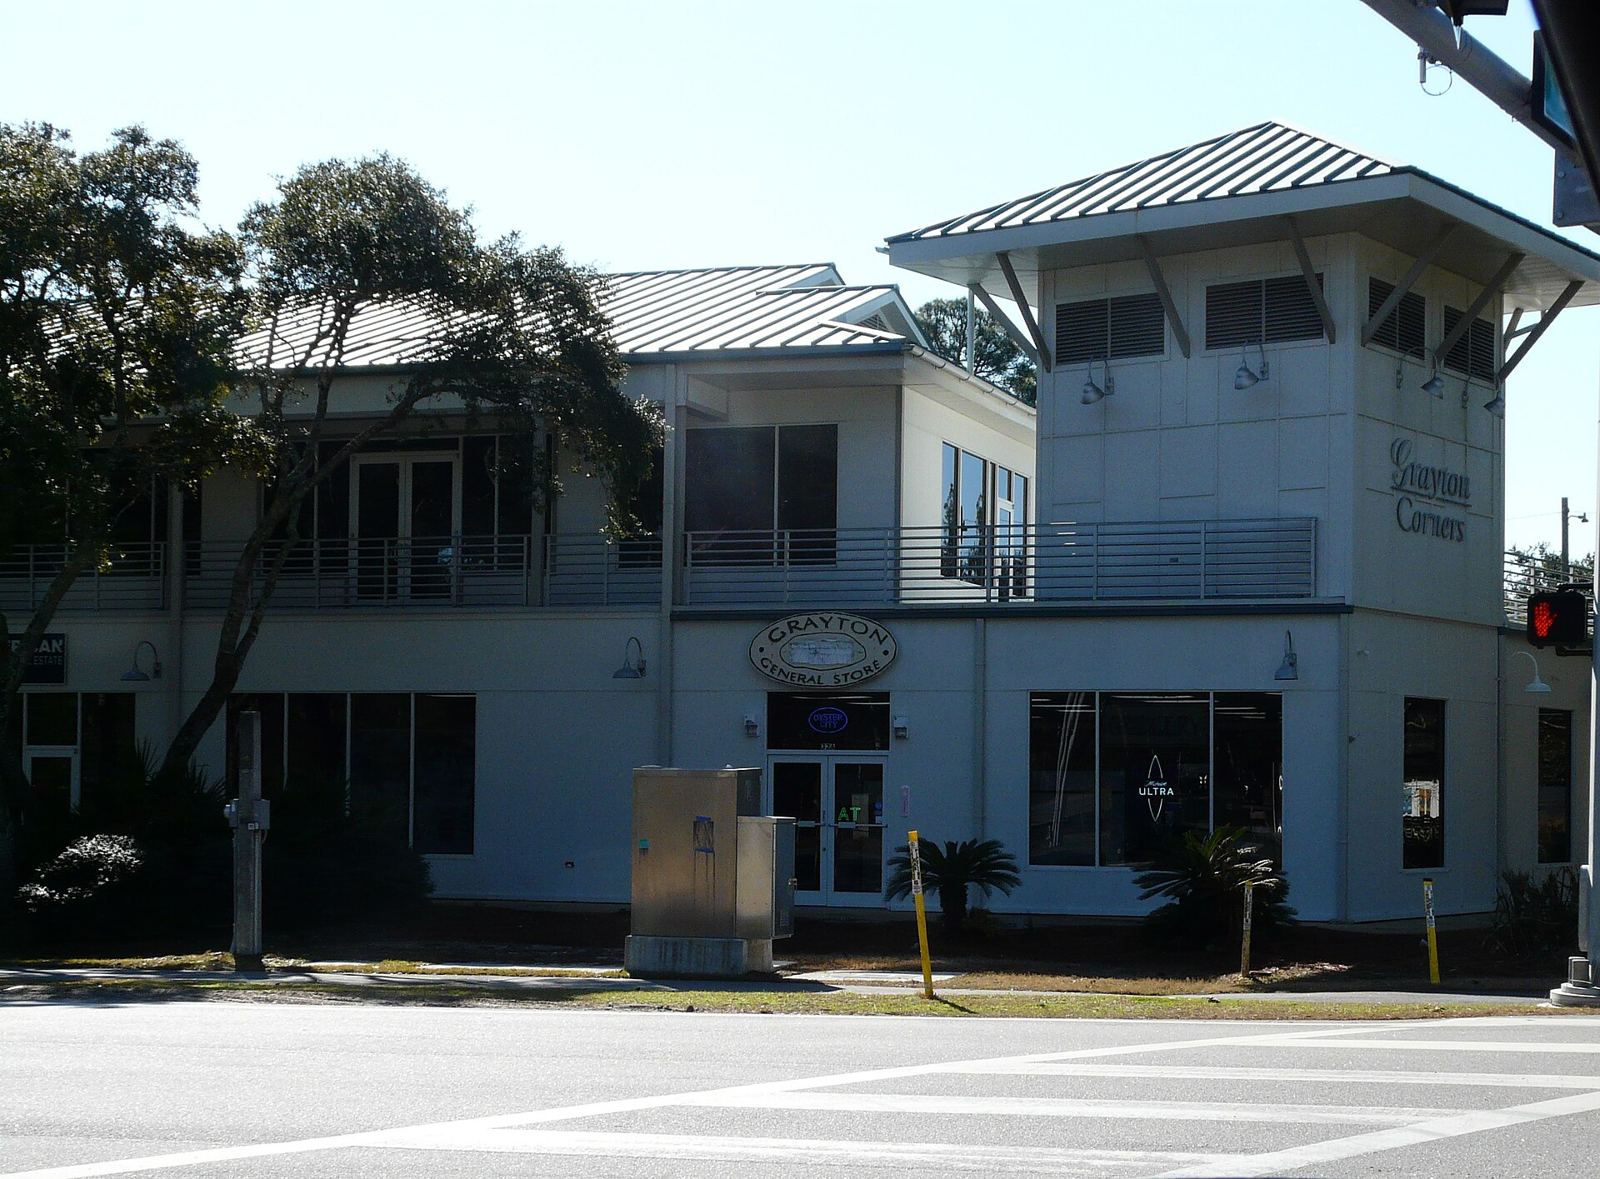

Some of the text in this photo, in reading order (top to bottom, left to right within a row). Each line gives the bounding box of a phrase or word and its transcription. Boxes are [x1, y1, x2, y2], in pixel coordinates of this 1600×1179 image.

[1390, 437, 1471, 500] Grayton
[1396, 495, 1465, 542] Corners
[767, 615, 888, 645] GRAYTON
[760, 657, 881, 685] GENERAL STORE
[1138, 787, 1175, 796] ULTRA
